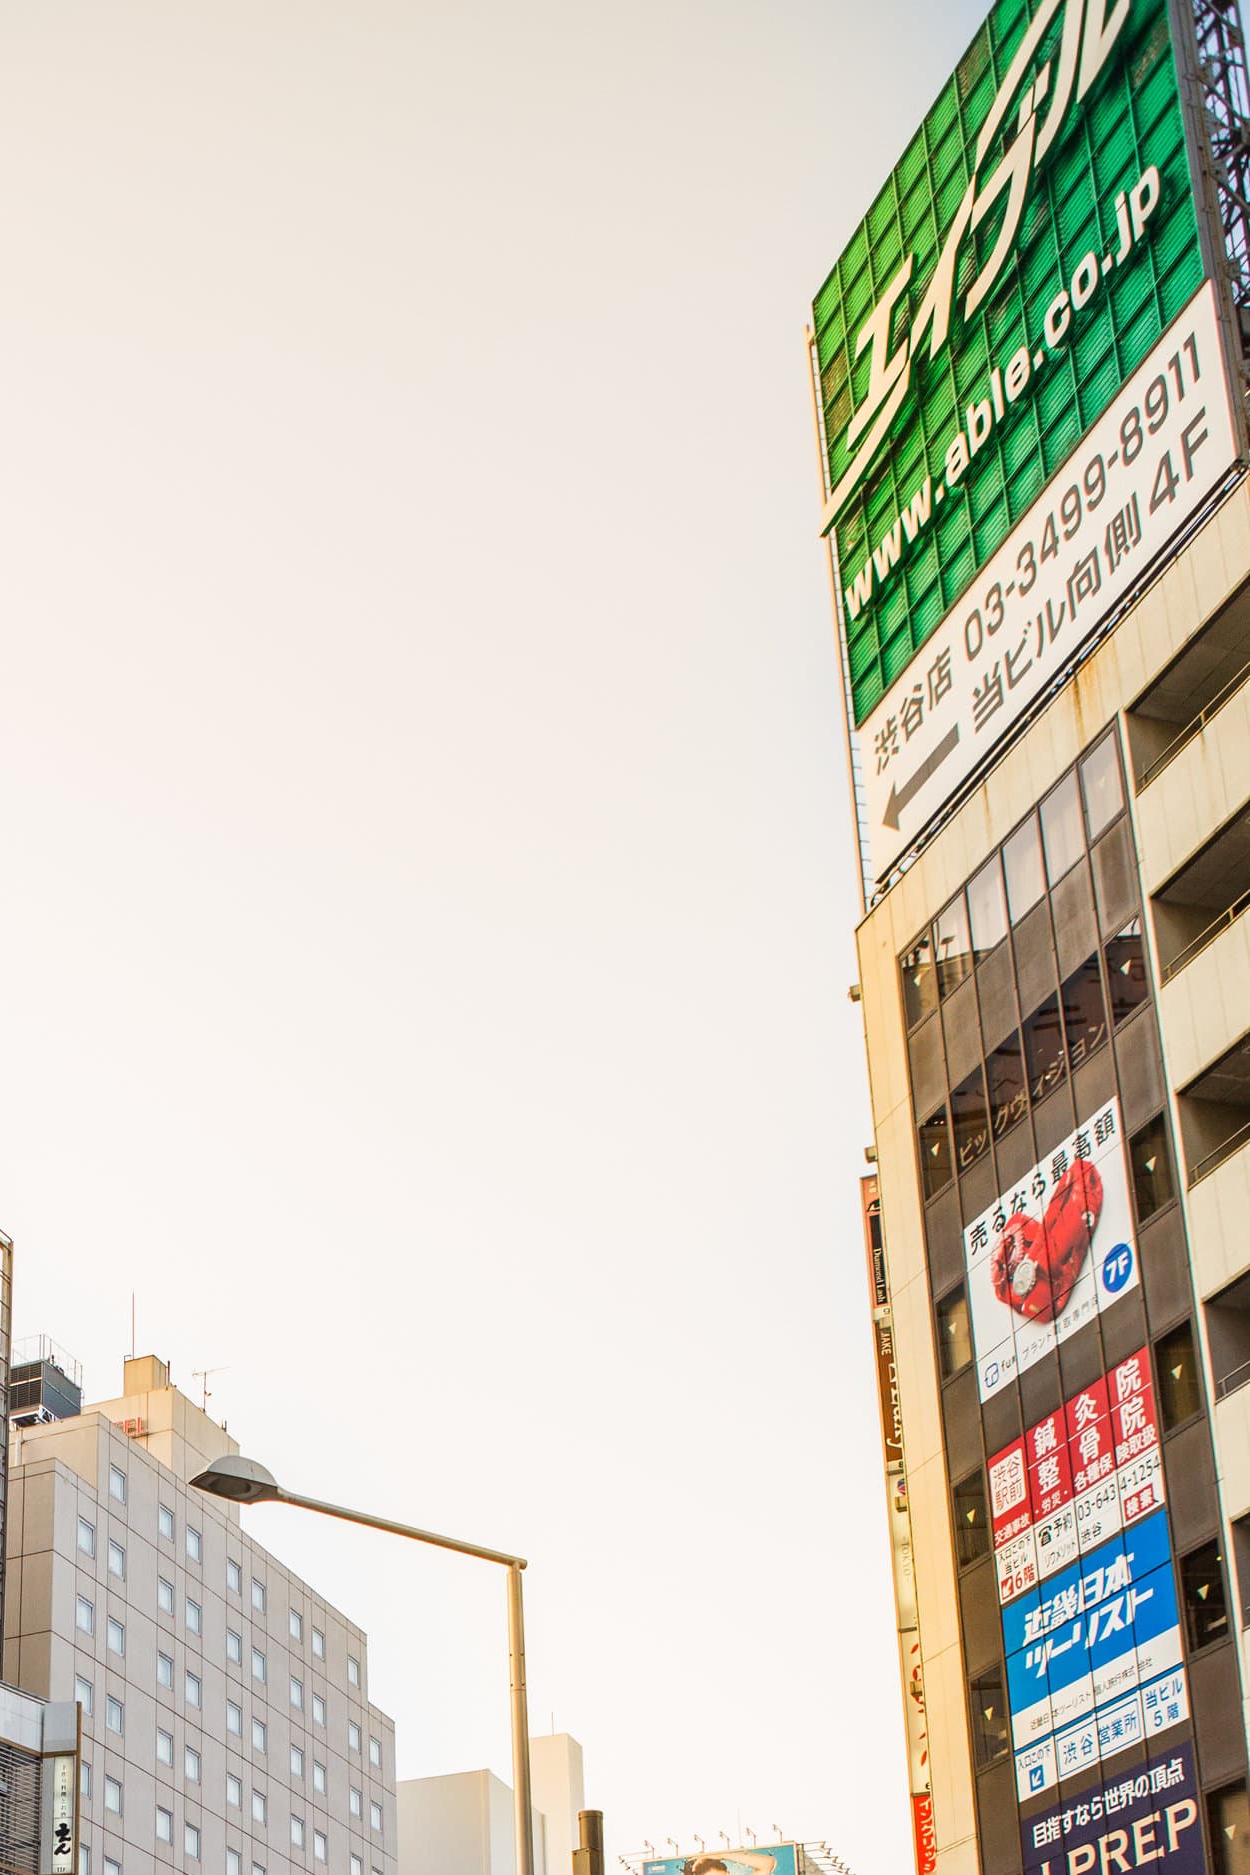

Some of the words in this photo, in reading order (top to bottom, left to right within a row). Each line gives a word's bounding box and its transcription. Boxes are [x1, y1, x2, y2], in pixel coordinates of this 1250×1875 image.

[844, 164, 1162, 622] www.able.co.jp
[873, 645, 953, 776] 渋谷店
[964, 331, 1202, 663] 03-3499-8911
[1104, 1250, 1131, 1286] 7F
[1022, 1551, 1135, 1648] 近畿日本
[1024, 1588, 1154, 1679] ツーリスト
